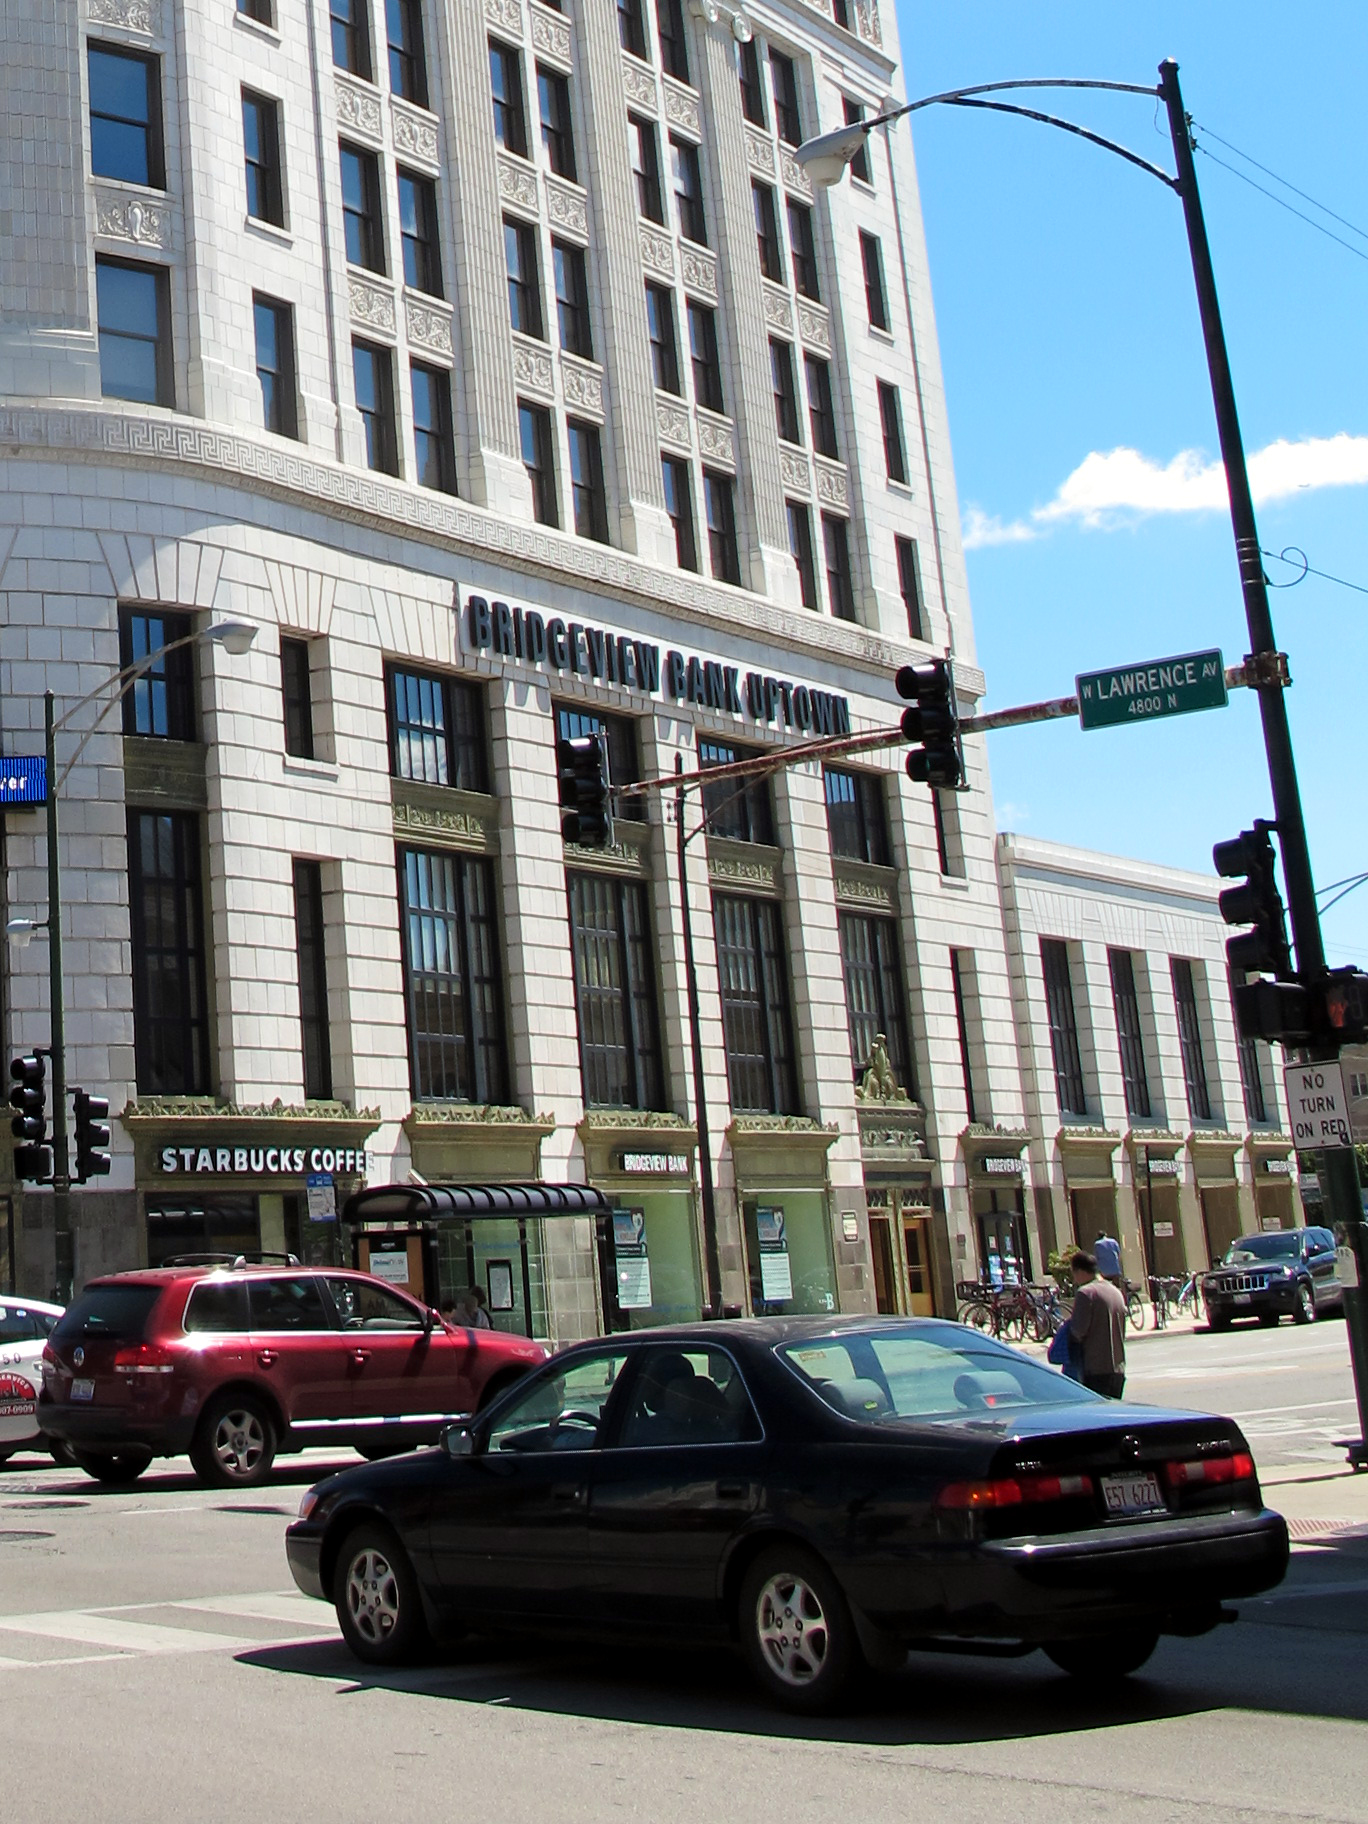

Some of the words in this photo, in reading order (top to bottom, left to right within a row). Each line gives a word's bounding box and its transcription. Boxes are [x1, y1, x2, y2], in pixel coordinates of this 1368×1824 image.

[469, 595, 659, 692] BRIDGEVIEW
[667, 650, 742, 713] BANK
[745, 672, 851, 735] UPTOWN
[1083, 684, 1092, 699] W
[1097, 662, 1197, 700] LAWRENCE
[1202, 661, 1218, 677] AV
[1128, 697, 1161, 714] 4800
[1168, 694, 1178, 709] N
[1303, 1074, 1324, 1089] NO
[1300, 1096, 1335, 1113] TURN
[1296, 1122, 1314, 1138] ON
[1321, 1119, 1347, 1136] RED
[162, 1147, 304, 1172] STARBUCKS
[311, 1148, 374, 1173] COFFEE
[625, 1154, 667, 1171] BRIDGEVIEW
[668, 1154, 688, 1172] BANK
[1133, 1482, 1159, 1505] 6227
